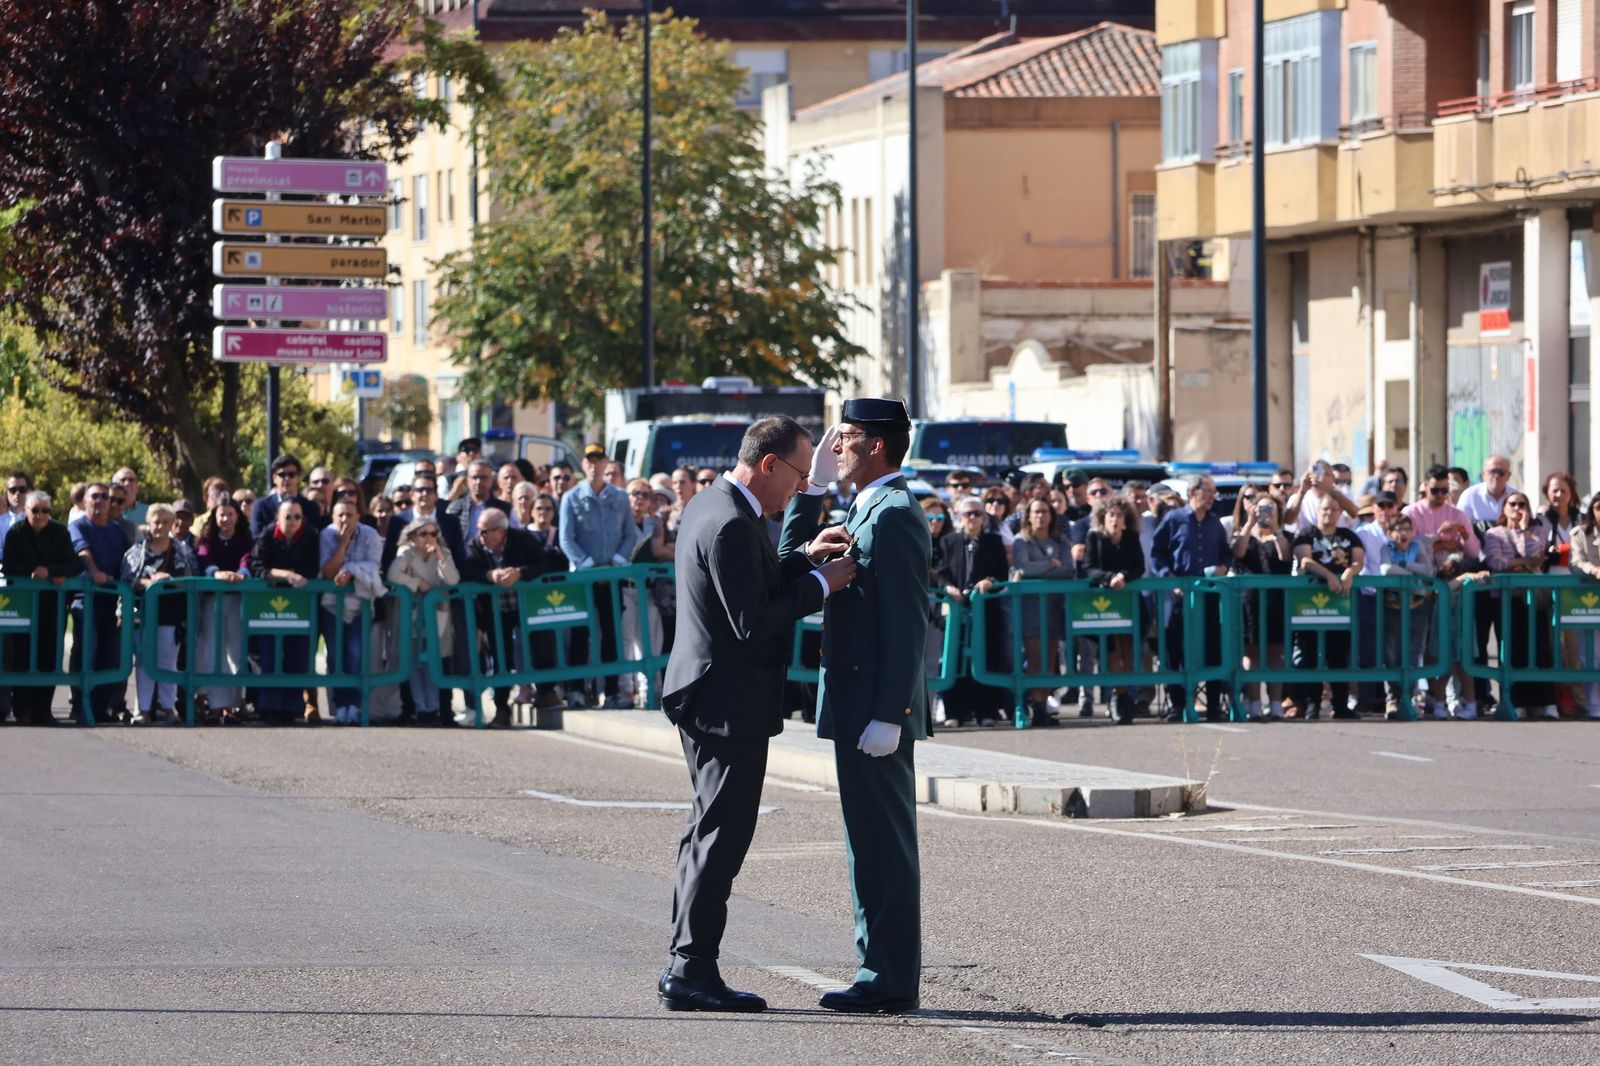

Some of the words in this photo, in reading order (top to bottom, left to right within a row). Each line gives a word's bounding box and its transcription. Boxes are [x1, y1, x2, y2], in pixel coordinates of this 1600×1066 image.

[226, 175, 291, 187] provincial
[247, 210, 260, 226] P
[307, 213, 332, 225] San
[330, 257, 381, 269] parador
[285, 335, 328, 346] catedral
[343, 336, 382, 347] castillo
[276, 348, 309, 357] museo
[312, 346, 354, 358] Baltasar
[357, 347, 382, 359] Lobo
[676, 456, 738, 468] GUARDIA
[947, 454, 1010, 467] GUARDIA
